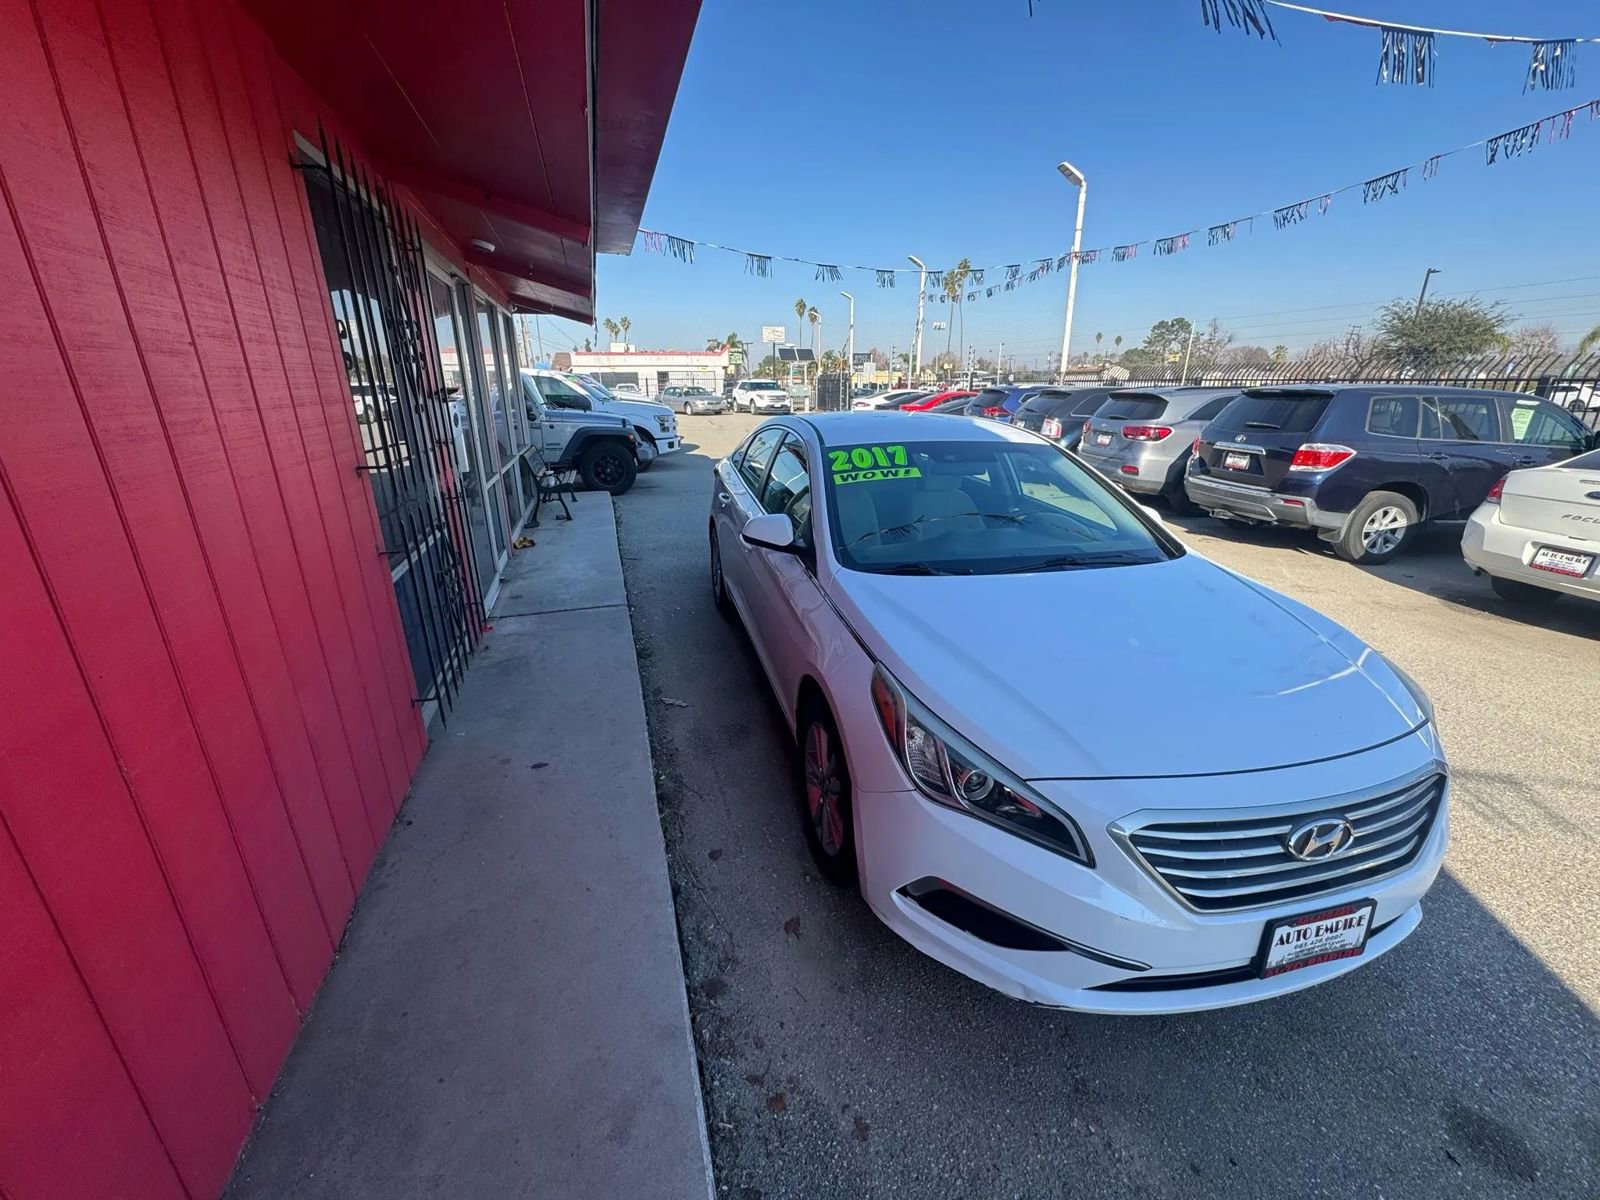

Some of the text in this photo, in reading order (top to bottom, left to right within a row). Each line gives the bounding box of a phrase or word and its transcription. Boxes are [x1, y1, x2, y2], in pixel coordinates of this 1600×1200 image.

[828, 446, 908, 471] 2017
[840, 469, 910, 482] WOW!
[1275, 928, 1312, 946] AUTO
[1315, 915, 1366, 936] EMPIRE
